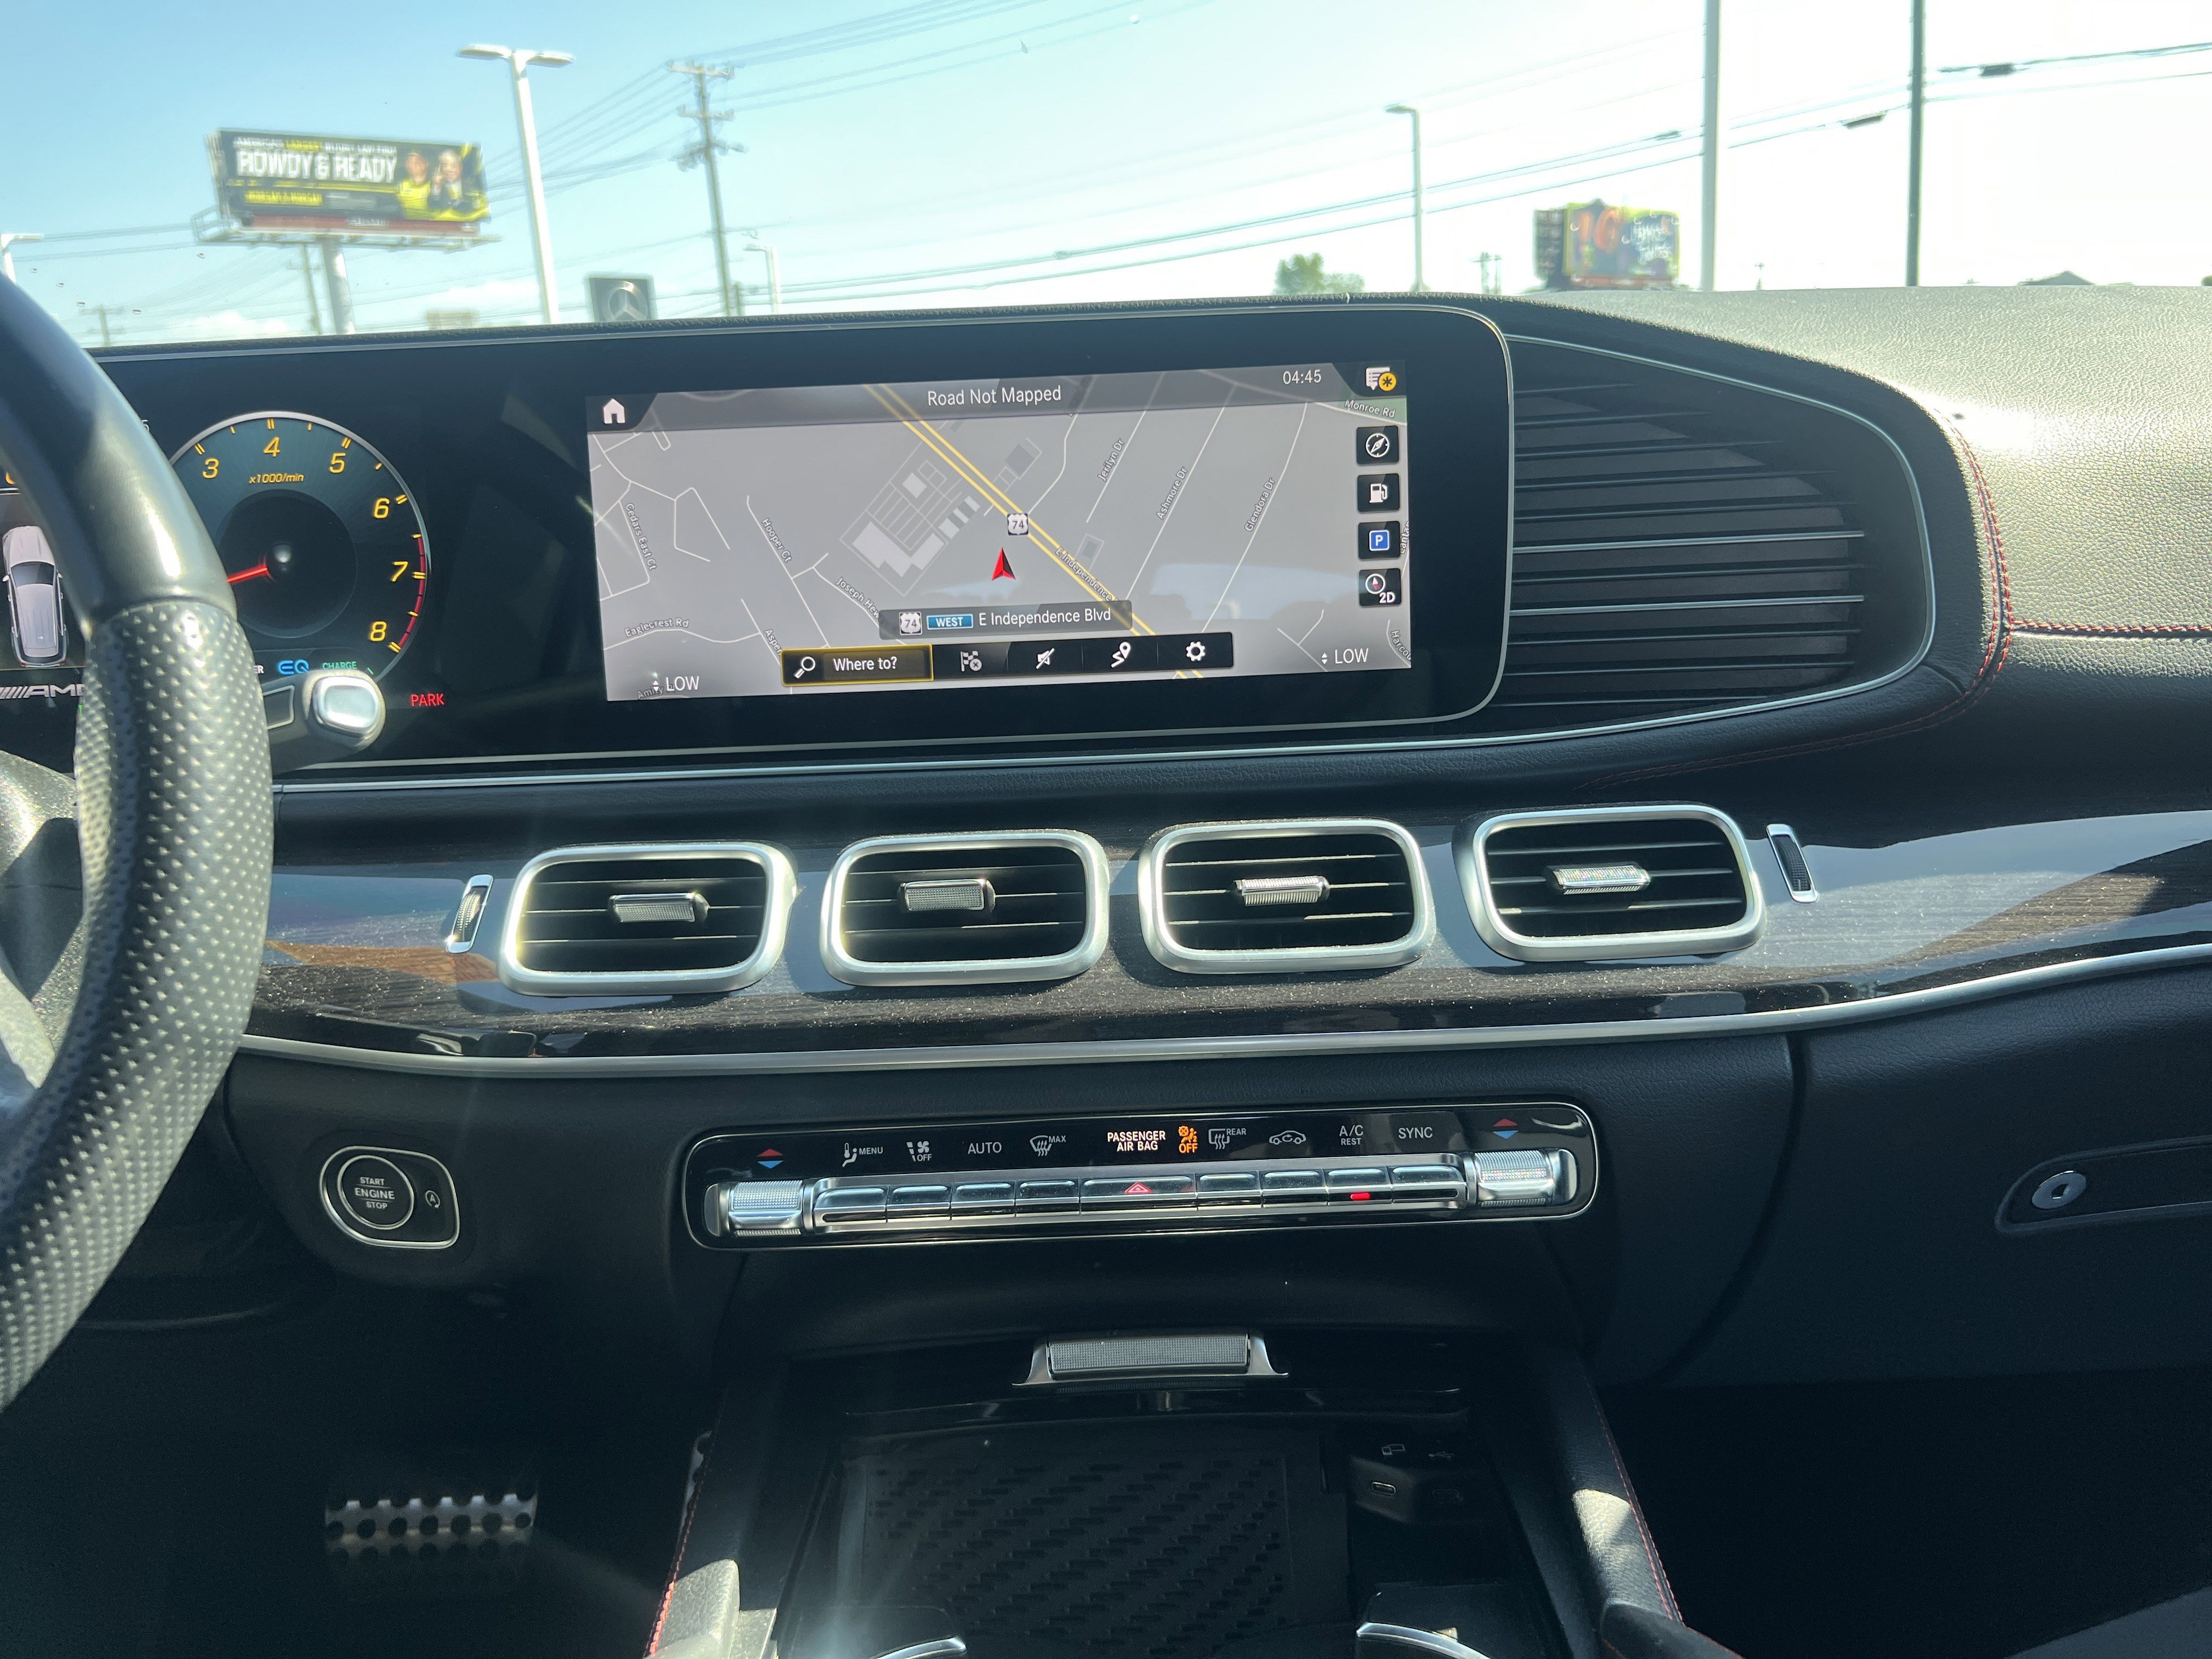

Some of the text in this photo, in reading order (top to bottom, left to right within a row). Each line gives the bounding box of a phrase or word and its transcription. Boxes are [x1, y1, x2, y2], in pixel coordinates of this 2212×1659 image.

[236, 150, 397, 183] ROWDY & READY
[1283, 369, 1322, 384] 04:45
[928, 385, 1062, 406] Road Not Mapped
[1344, 399, 1396, 418] Monroe Rd
[263, 436, 281, 457] 4
[329, 453, 346, 474] 5
[1098, 438, 1125, 482] Jerilyn Dr
[202, 458, 219, 479] 3
[249, 473, 304, 484] x1000/min
[1156, 466, 1188, 520] Ashmore Dr
[374, 498, 390, 519] 6
[1244, 477, 1276, 532] Glendora Dr
[1012, 520, 1025, 530] 74
[625, 503, 657, 571] Cedars East Ct
[761, 518, 792, 563] Hooper Ct
[391, 561, 409, 582] 7
[1055, 546, 1112, 601] E Independence
[835, 577, 865, 602] Joseph
[1379, 591, 1396, 604] 2D
[905, 607, 1111, 628] 74 WEST E Independence Blvd
[370, 620, 387, 641] 8
[624, 617, 690, 637] Eaglecrest Rd
[833, 656, 898, 671] Where to?
[1335, 648, 1369, 664] LOW
[322, 661, 357, 670] CHARGE
[665, 676, 699, 691] LOW
[411, 693, 445, 707] PARK
[1107, 1130, 1166, 1142] PASSENGER
[1339, 1125, 1364, 1137] A/C
[1398, 1126, 1433, 1139] SYNC
[1049, 1135, 1066, 1143] MAX
[1116, 1140, 1158, 1152] AIR BAG
[1341, 1137, 1362, 1146] REST
[859, 1147, 884, 1155] MENU
[968, 1142, 1002, 1155] AUTO
[1178, 1143, 1198, 1153] OFF
[917, 1154, 932, 1162] OFF
[360, 1176, 385, 1186] START
[354, 1187, 395, 1200] ENGINE
